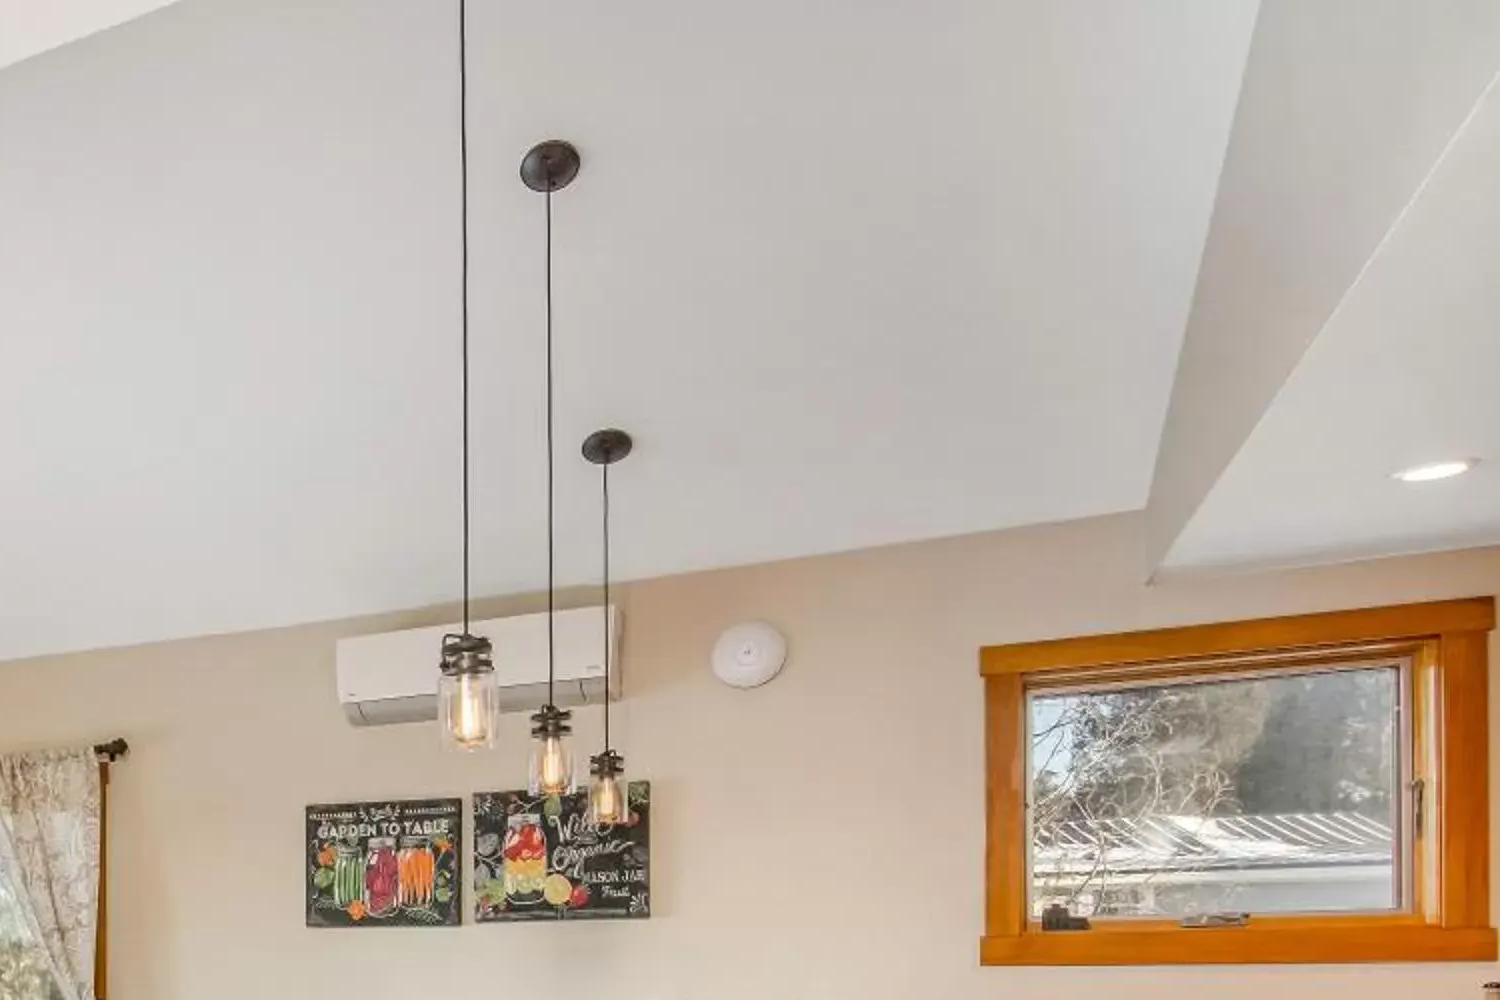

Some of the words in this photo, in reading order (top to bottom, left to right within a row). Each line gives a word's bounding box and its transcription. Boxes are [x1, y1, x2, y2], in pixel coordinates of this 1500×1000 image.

[317, 822, 377, 839] GARDEN
[379, 821, 400, 836] TO
[404, 818, 449, 835] TABLE
